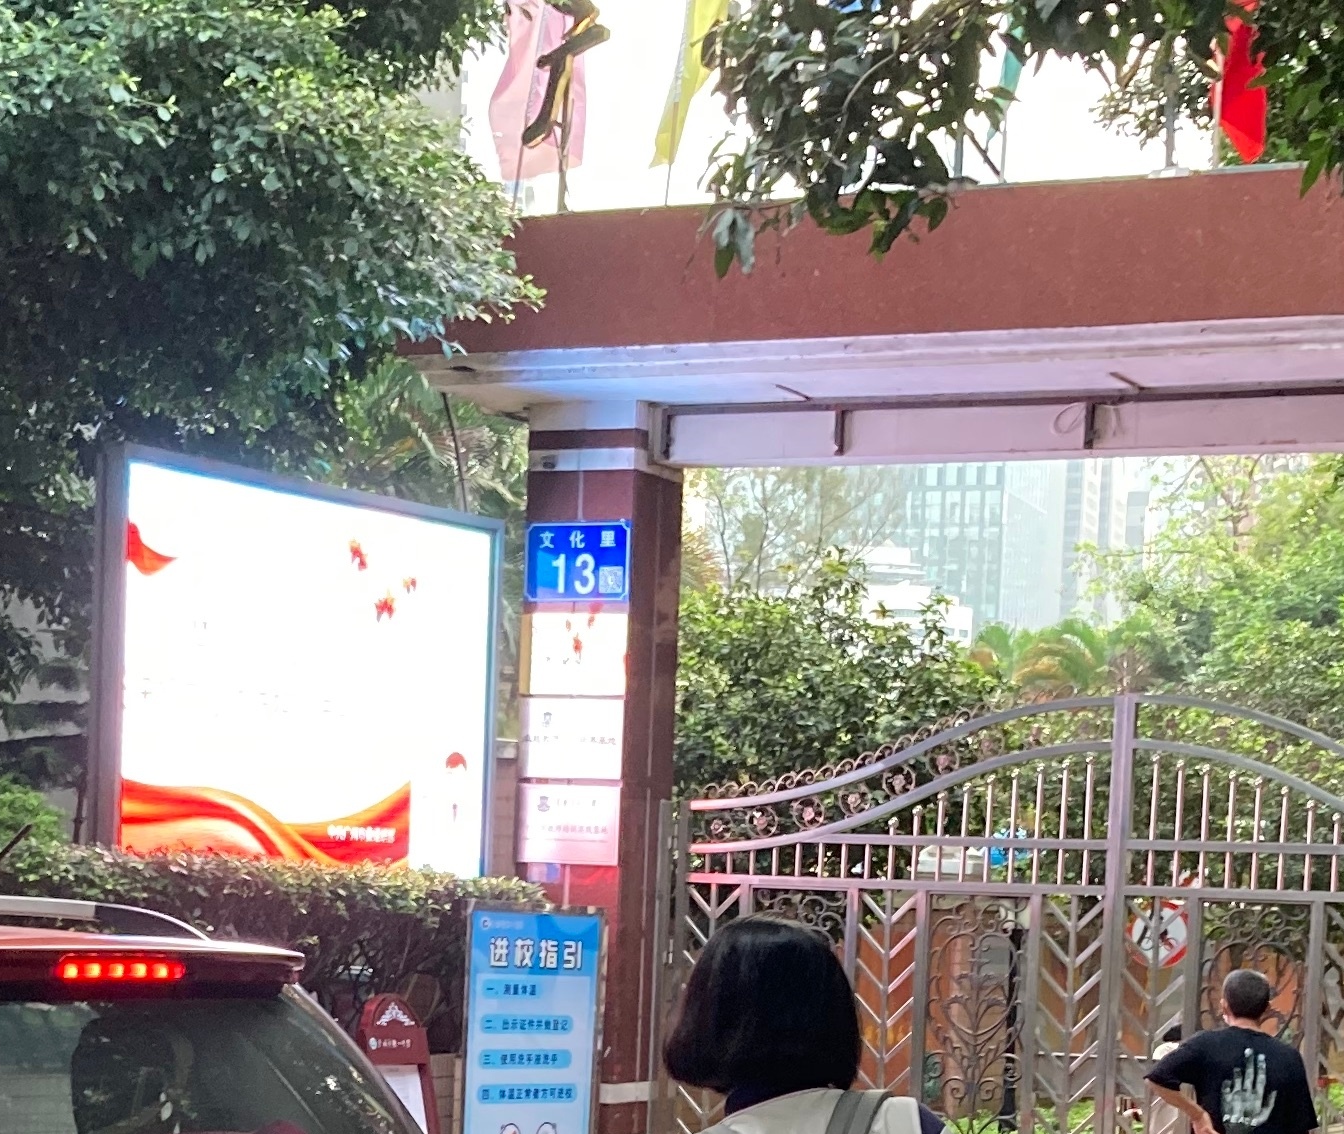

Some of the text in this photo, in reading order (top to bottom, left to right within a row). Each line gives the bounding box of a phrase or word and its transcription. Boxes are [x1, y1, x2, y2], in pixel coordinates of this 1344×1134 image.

[539, 530, 616, 548] 文化里
[551, 553, 596, 595] 13
[489, 937, 583, 969] 进校指引
